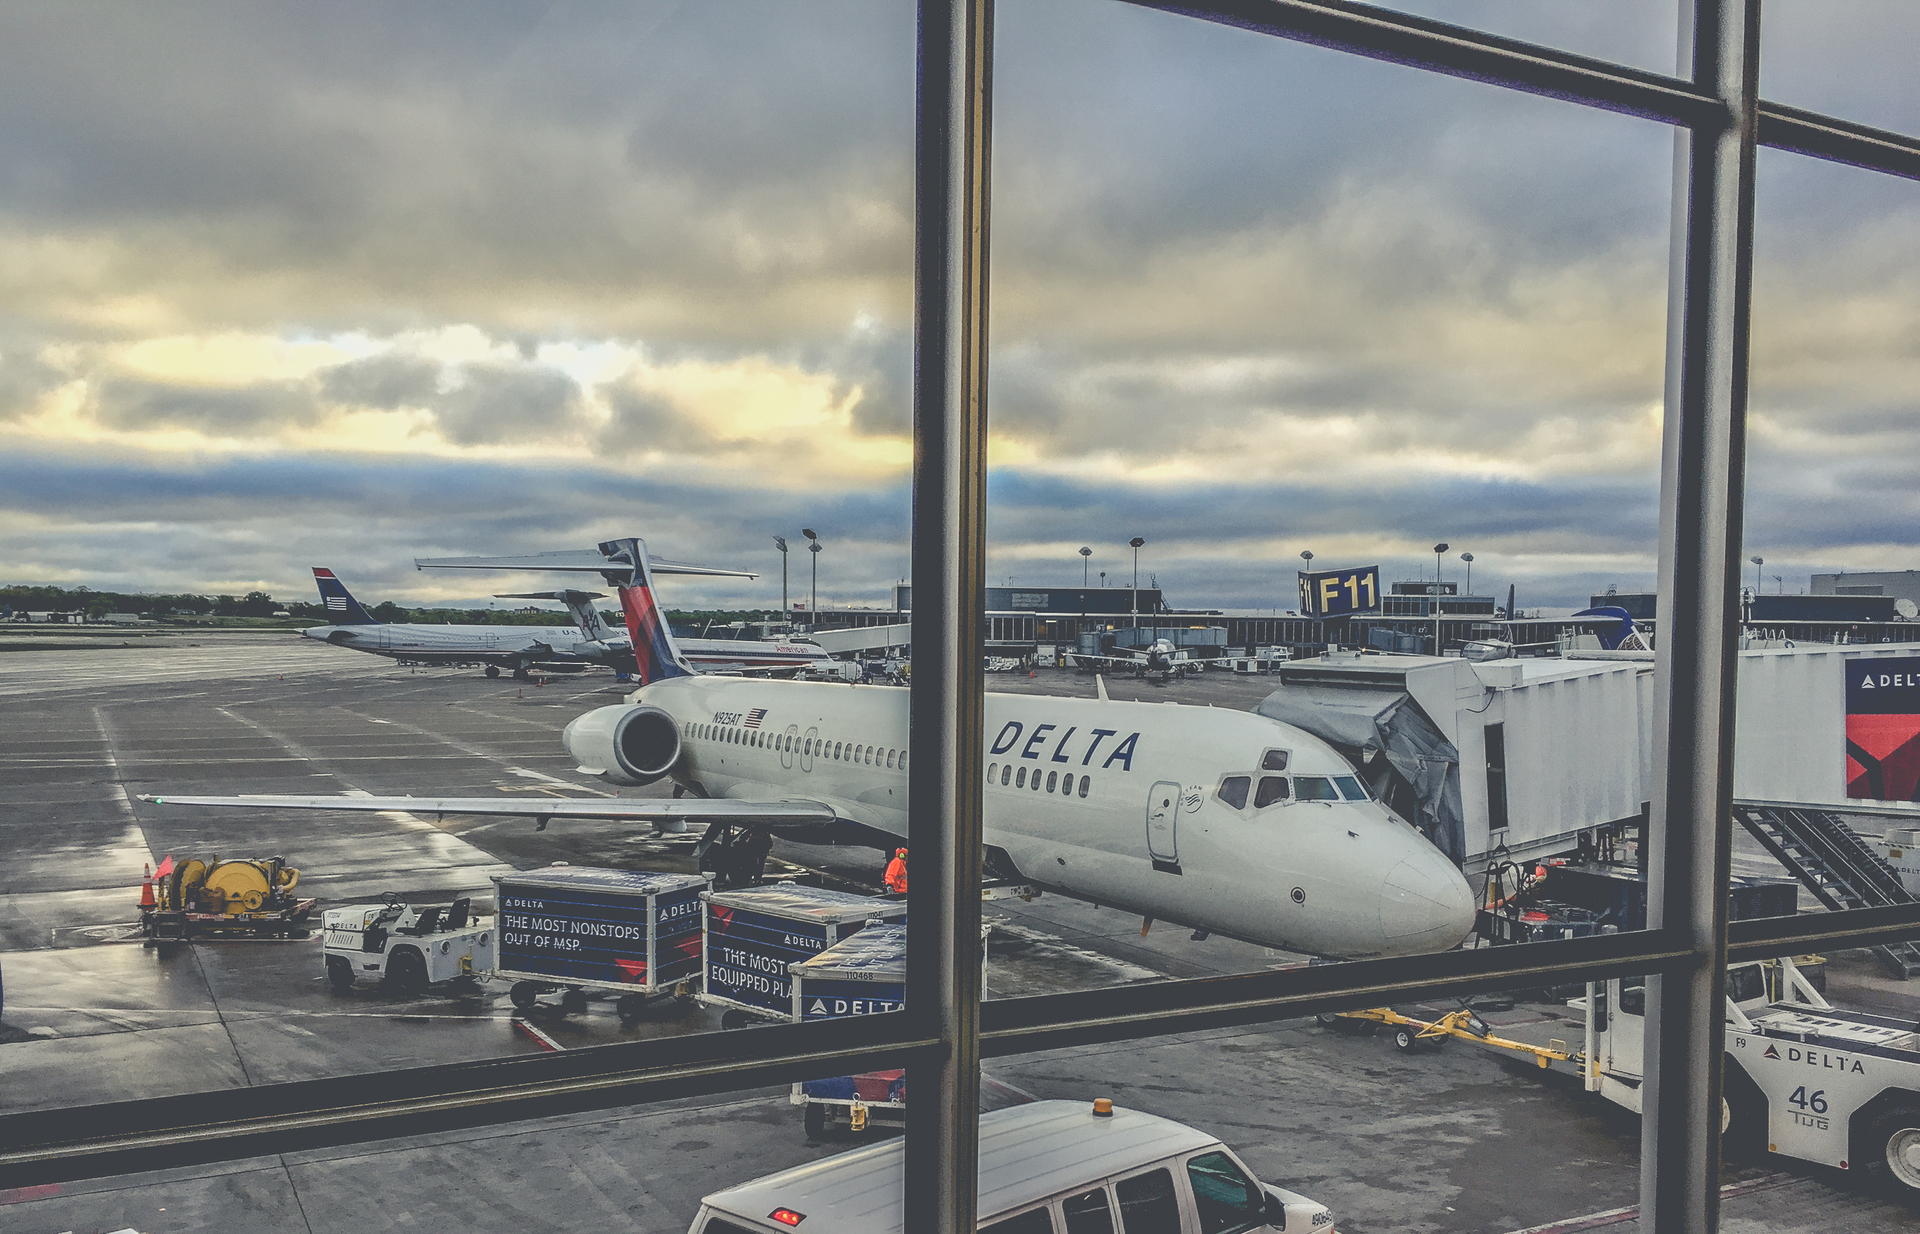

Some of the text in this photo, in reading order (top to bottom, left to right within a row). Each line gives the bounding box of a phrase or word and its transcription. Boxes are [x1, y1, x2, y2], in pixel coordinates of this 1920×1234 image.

[1300, 578, 1312, 613] F11
[1320, 573, 1375, 612] F11
[712, 711, 742, 726] N925AT
[990, 721, 1141, 771] DELTA
[514, 899, 543, 908] DELTA
[504, 932, 531, 946] OUT
[534, 935, 551, 947] OF
[505, 915, 640, 940] THE MOST NONSTOPS
[793, 936, 822, 949] DELTA
[723, 947, 786, 976] THE MOST
[712, 965, 769, 993] EQUIPPED
[846, 971, 874, 980] 110468
[1736, 1037, 1746, 1048] F9
[1789, 1048, 1865, 1075] DELTA
[1789, 1086, 1828, 1114] 46
[1787, 1110, 1829, 1130] TUG
